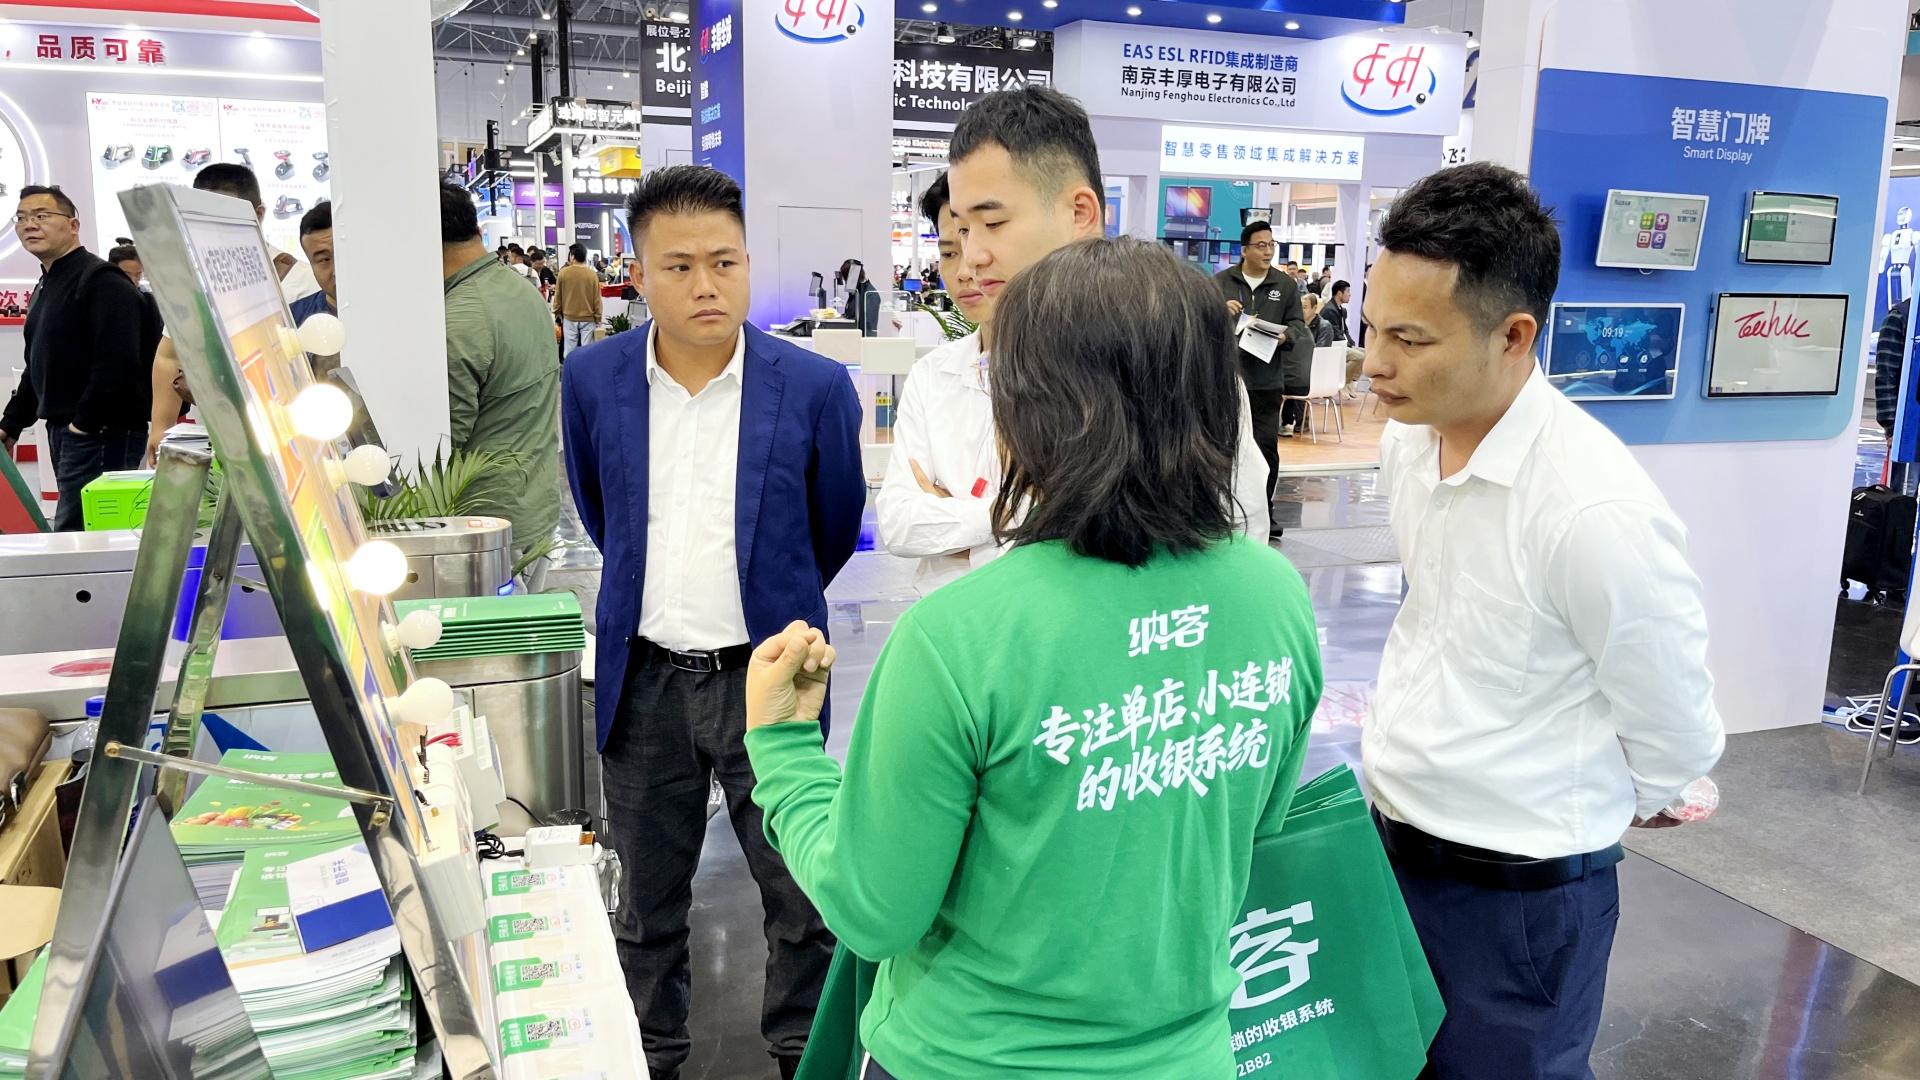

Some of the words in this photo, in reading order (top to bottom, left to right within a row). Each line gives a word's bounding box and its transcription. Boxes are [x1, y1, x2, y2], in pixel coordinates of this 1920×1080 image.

[656, 42, 691, 73] 北
[1123, 43, 1153, 59] EAS
[1158, 46, 1184, 62] ESL
[1190, 48, 1298, 73] RFID集成制造商
[893, 59, 1051, 93] 科技有限公司
[1121, 65, 1297, 95] 南京丰厚电子有限公司
[1121, 87, 1161, 100] Nanjing
[1163, 90, 1205, 102] Fenghou
[1208, 93, 1260, 105] Electronics
[1671, 106, 1771, 145] 智慧门牌
[1164, 140, 1360, 165] 智慧零售领域集成解决方案
[1683, 145, 1714, 159] Smart
[1716, 147, 1752, 165] Display
[1602, 327, 1624, 338] 09:19
[1033, 656, 1293, 765] 专注单店、小连锁
[1076, 718, 1272, 811] 的收银系统
[1236, 1052, 1272, 1077] 2B82
